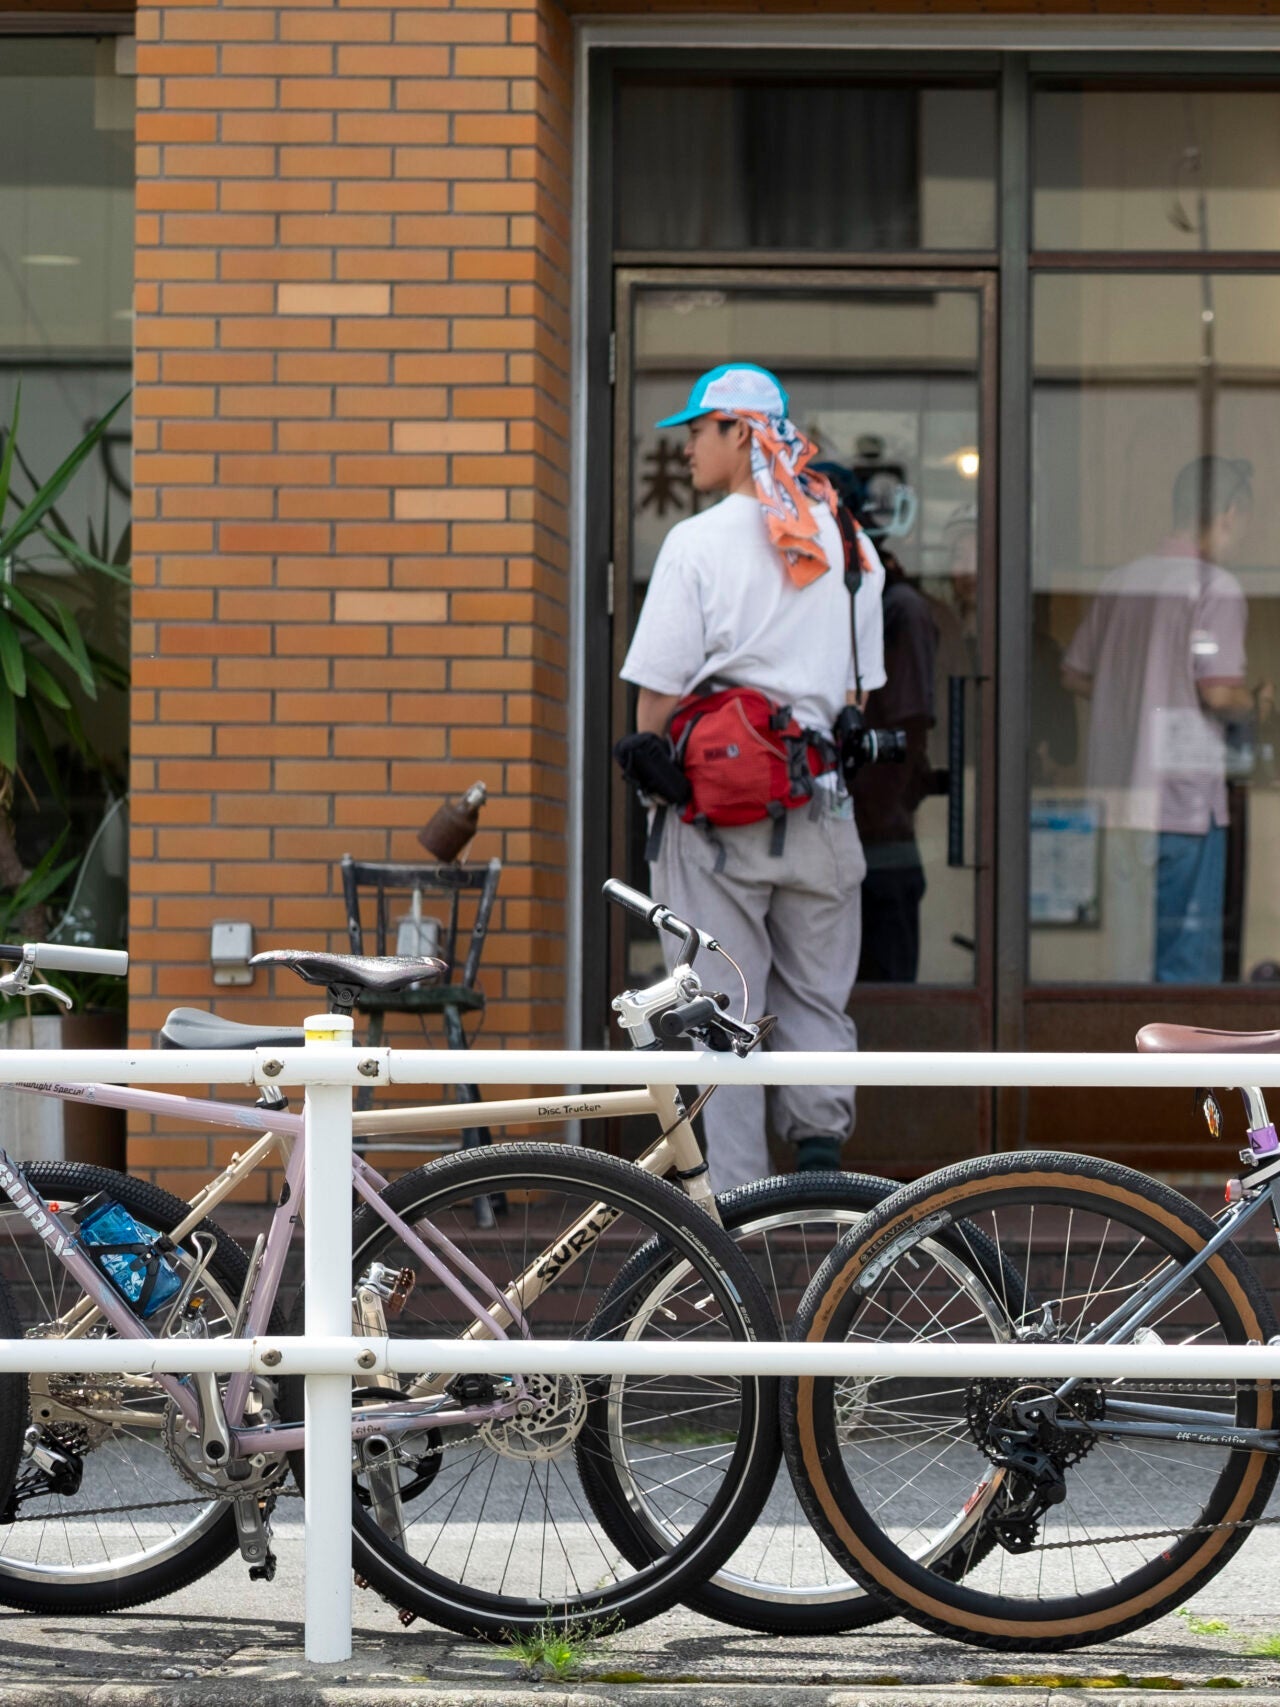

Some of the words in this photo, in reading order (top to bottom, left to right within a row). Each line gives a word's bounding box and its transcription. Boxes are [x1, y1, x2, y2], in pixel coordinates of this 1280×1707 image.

[53, 1084, 86, 1095] Special
[538, 1107, 562, 1116] Disc
[563, 1103, 602, 1114] Trucker
[0, 1163, 76, 1256] SURLY
[867, 1219, 911, 1254] TERAVAIL
[537, 1205, 619, 1283] SURLY
[680, 1225, 721, 1269] SCHWALBE
[740, 1306, 752, 1324] BIG
